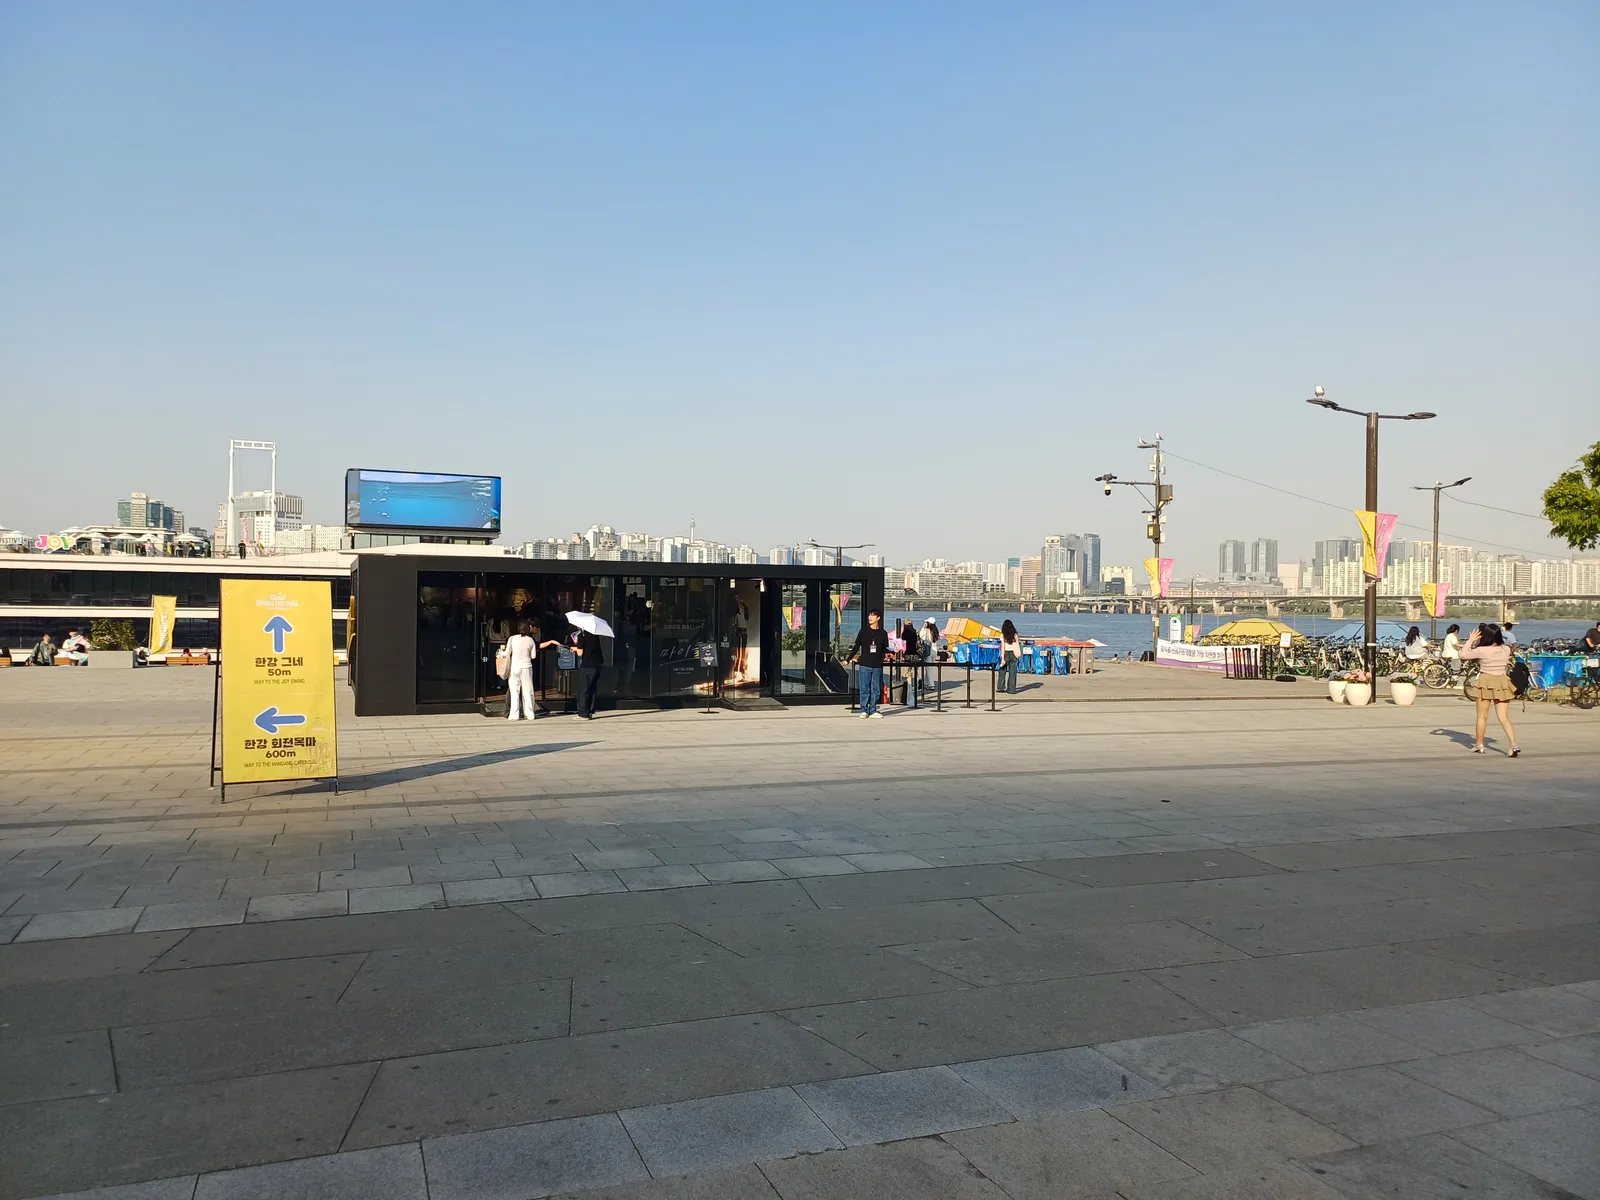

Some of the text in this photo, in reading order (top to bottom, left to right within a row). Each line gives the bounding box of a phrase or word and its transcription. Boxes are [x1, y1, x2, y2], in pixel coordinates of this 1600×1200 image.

[35, 535, 74, 549] JOY
[255, 657, 303, 667] 한강 그네
[267, 668, 292, 676] 50m
[245, 737, 316, 749] 한강 회전목마
[266, 750, 296, 758] 600m
